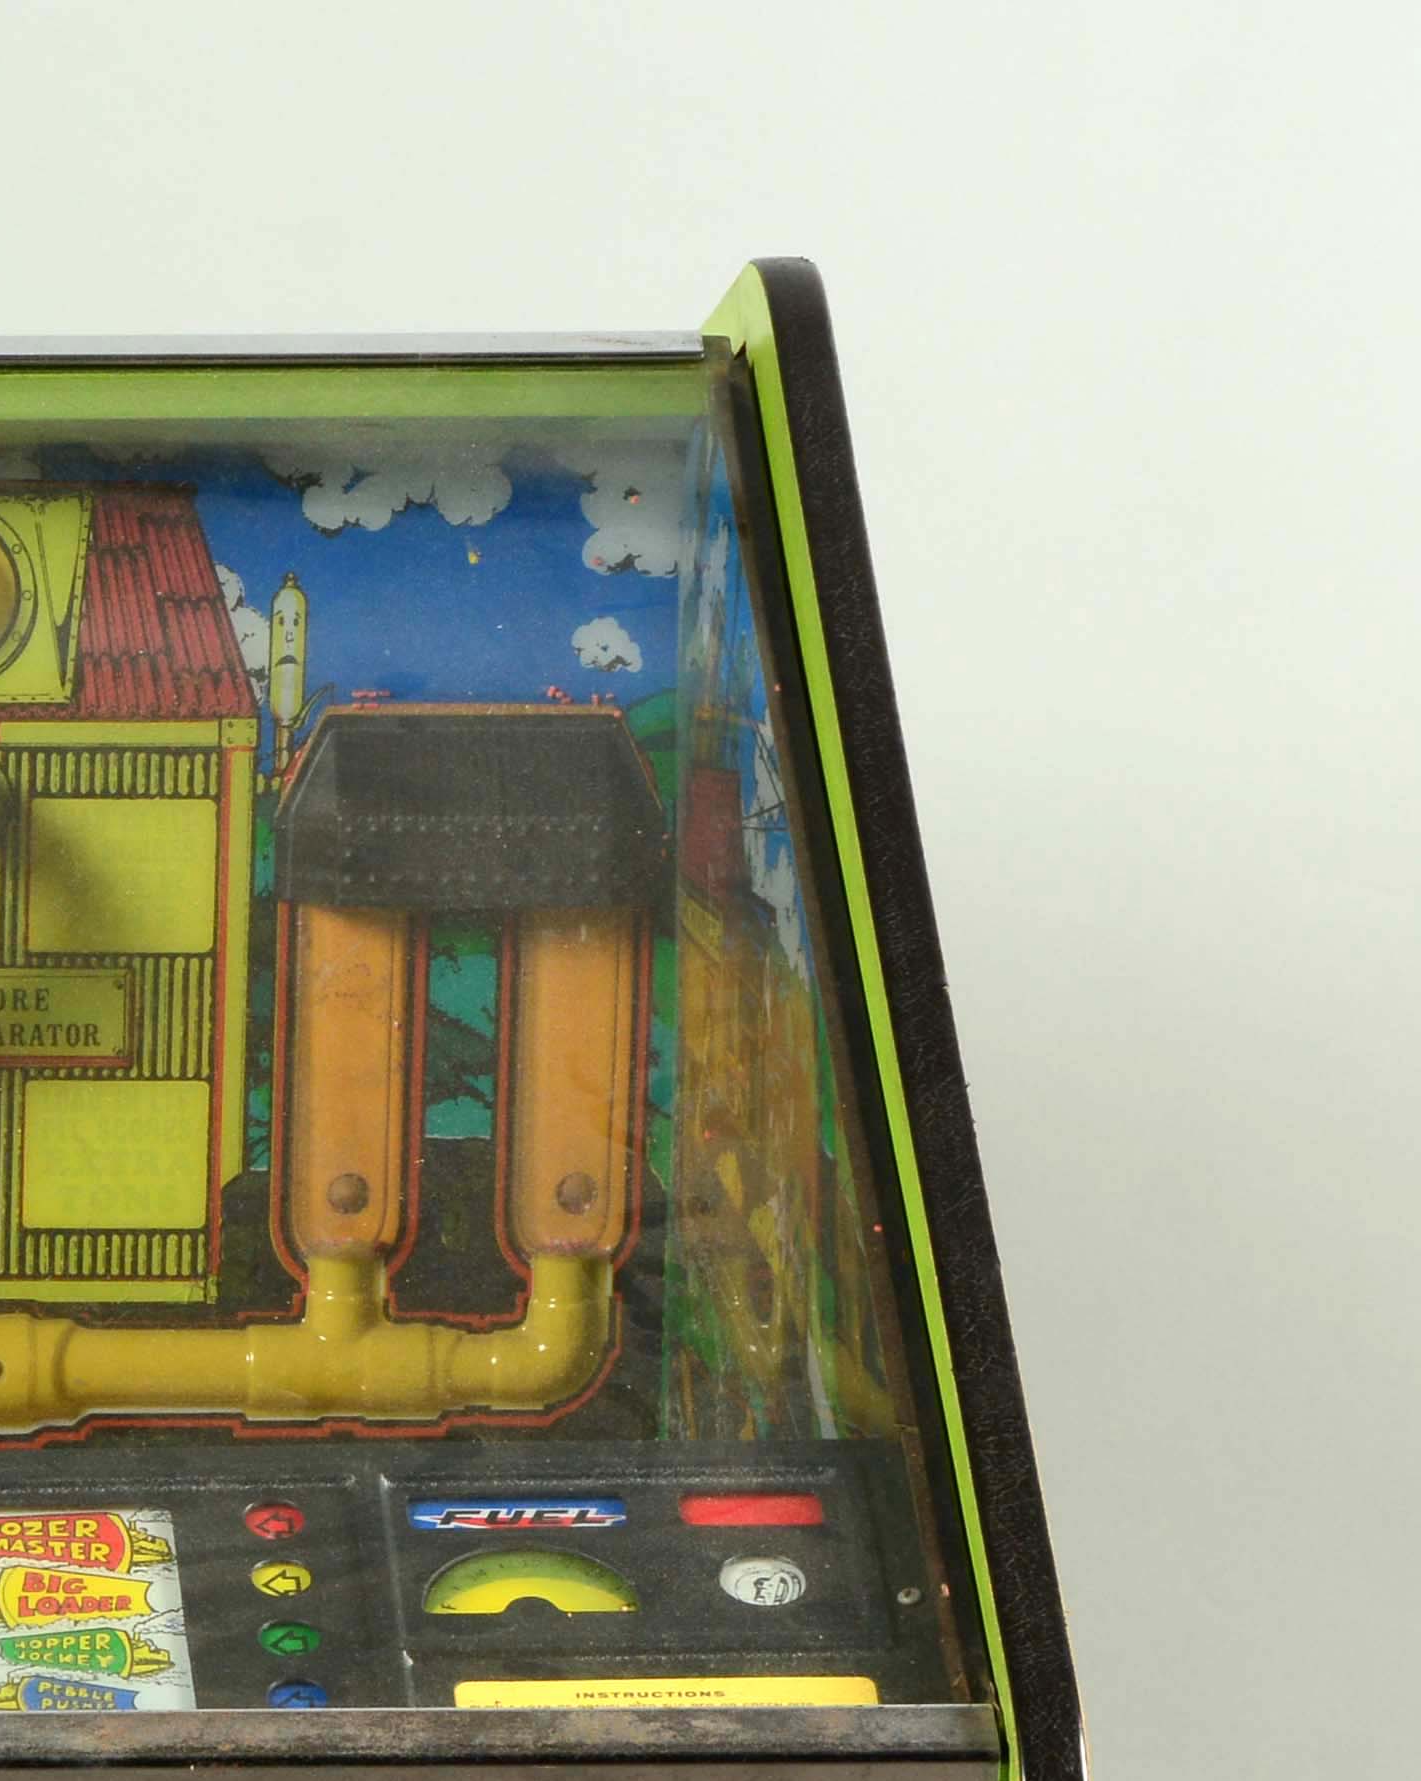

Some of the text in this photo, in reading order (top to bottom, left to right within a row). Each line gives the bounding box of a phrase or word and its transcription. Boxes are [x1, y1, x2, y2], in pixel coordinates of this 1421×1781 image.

[438, 1509, 612, 1526] FUEL
[22, 1572, 87, 1594] BIG
[18, 1595, 131, 1617] LOADER
[15, 1634, 111, 1649] HOPPER
[18, 1653, 114, 1668] JOCKEY
[38, 1681, 115, 1701] PEBBLE
[576, 1690, 726, 1699] INSTRUCTIONS
